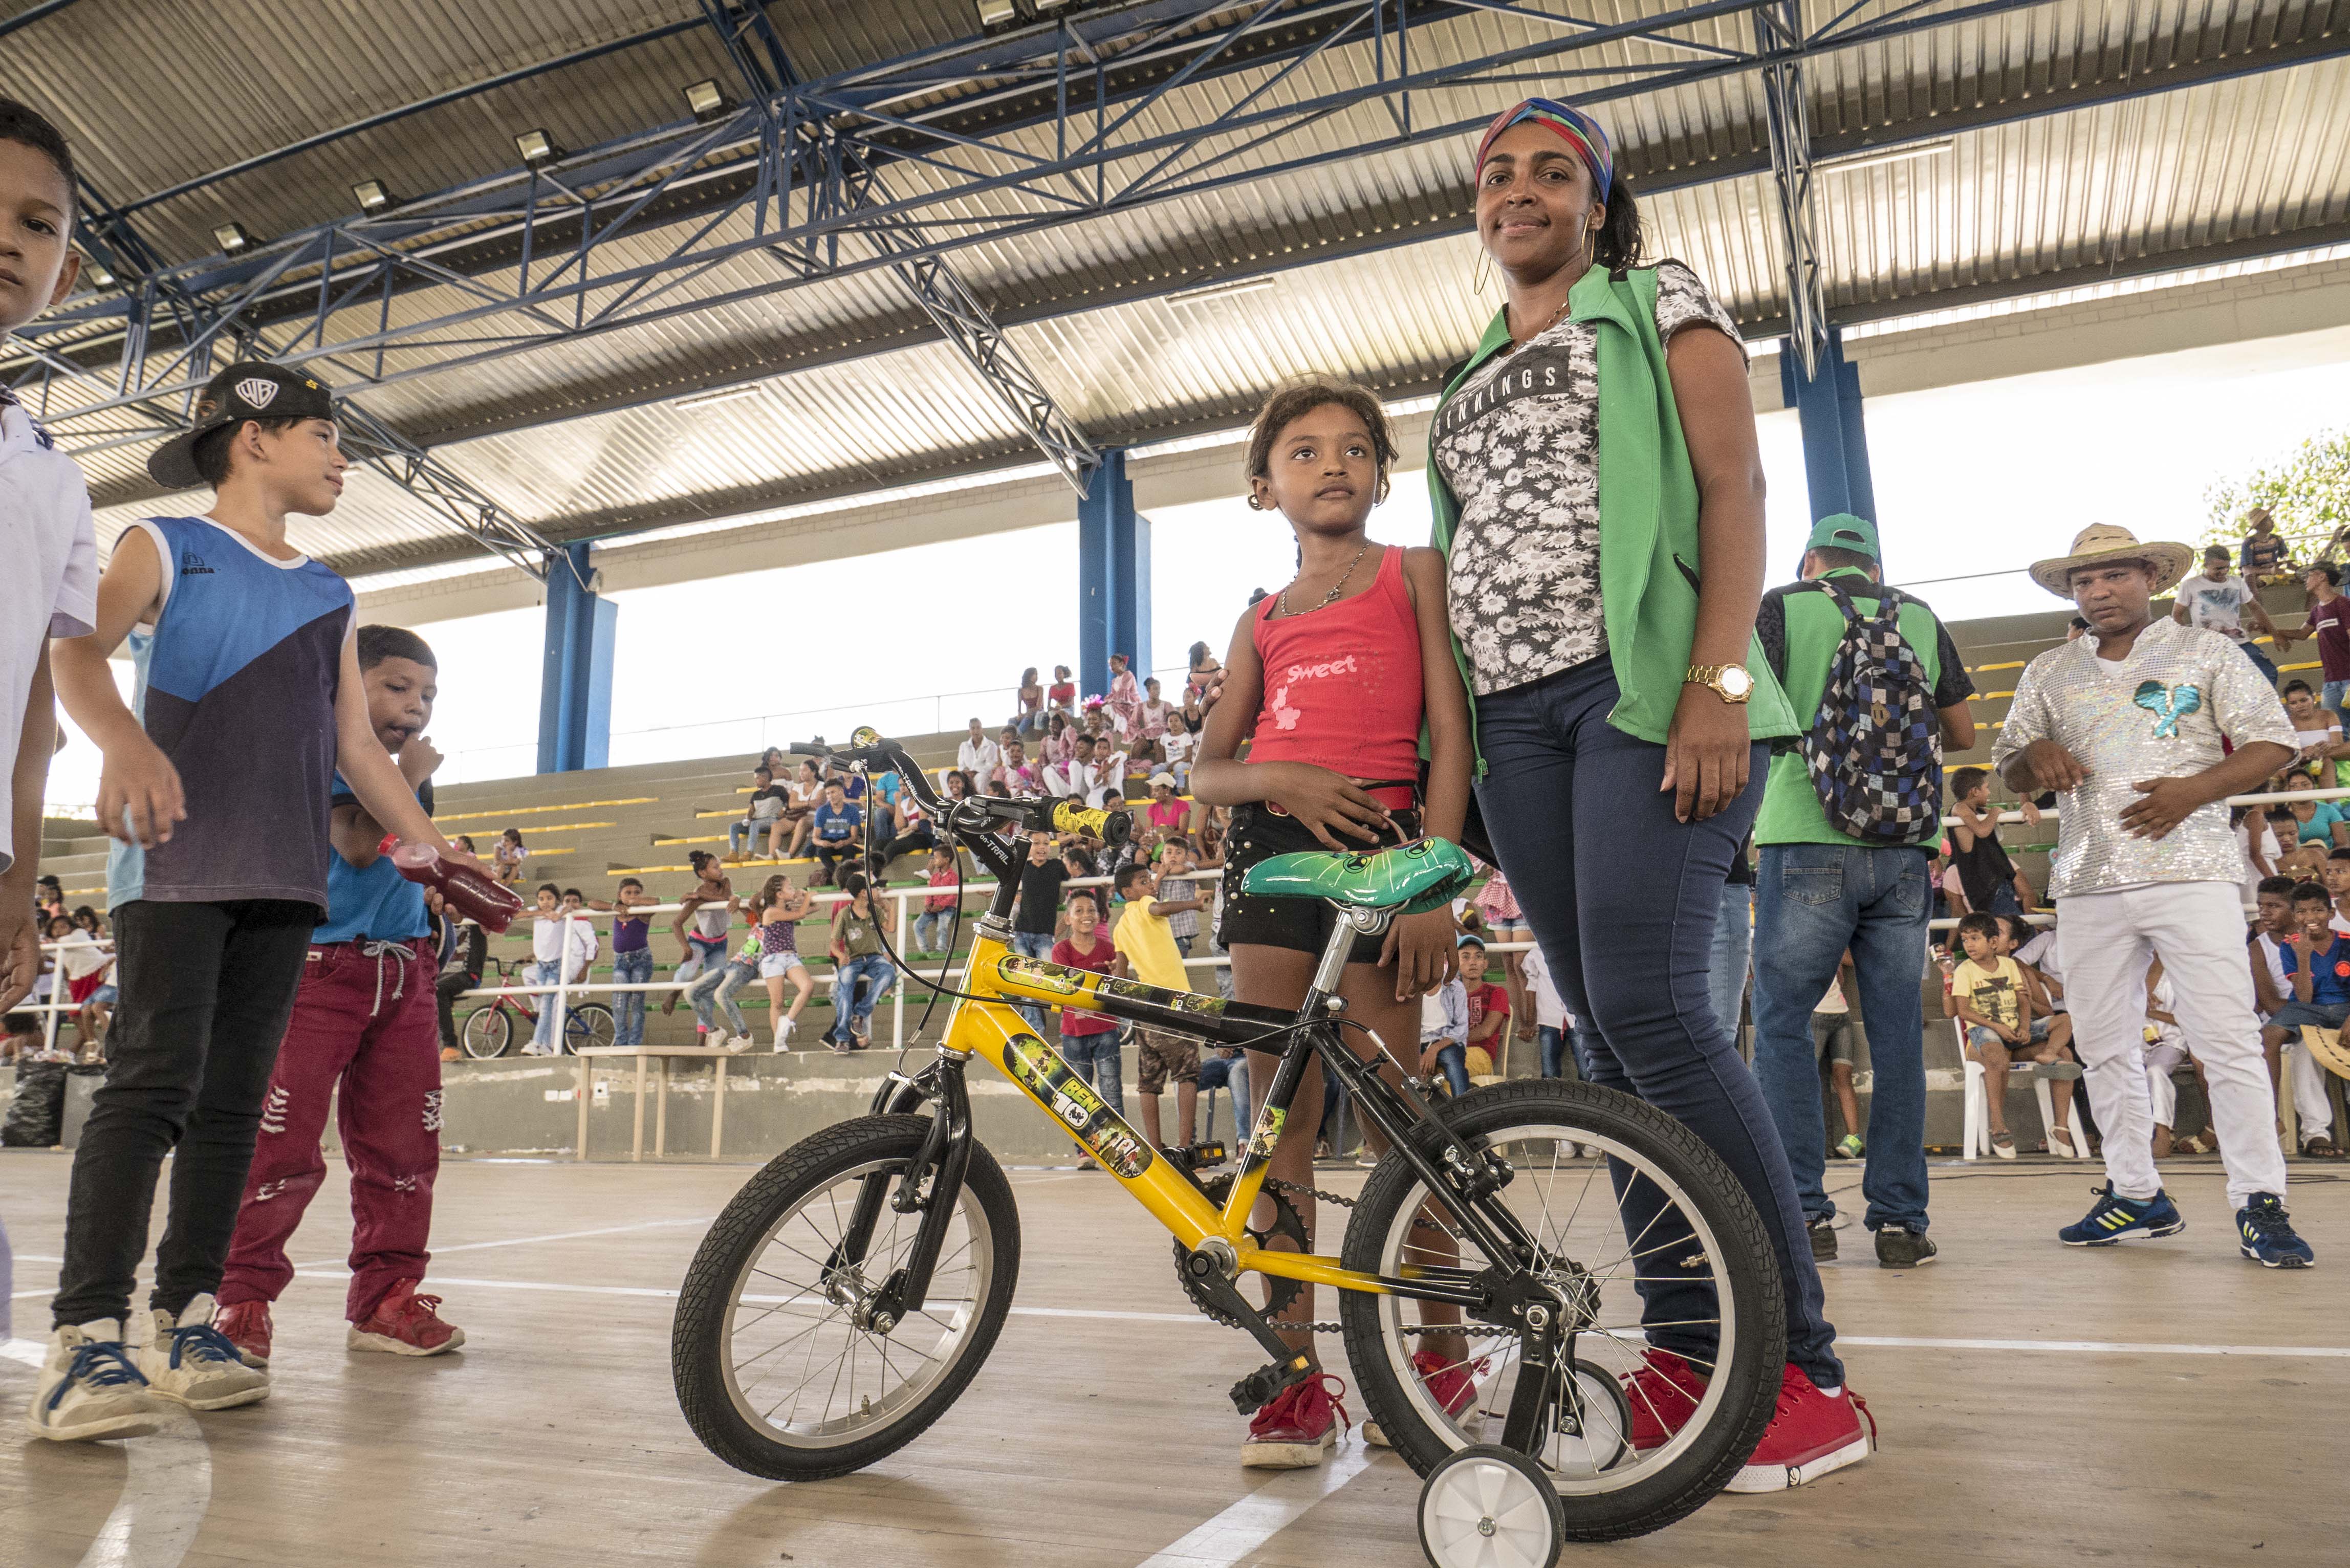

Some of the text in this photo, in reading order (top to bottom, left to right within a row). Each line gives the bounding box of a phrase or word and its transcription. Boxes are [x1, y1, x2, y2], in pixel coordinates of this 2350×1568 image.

[238, 380, 275, 406] WB
[1434, 366, 1556, 438] GINNINGS
[1287, 655, 1357, 684] sweet
[979, 834, 1009, 865] on-TRAIL
[1051, 1091, 1090, 1128] 10
[1062, 1078, 1102, 1114] BEN
